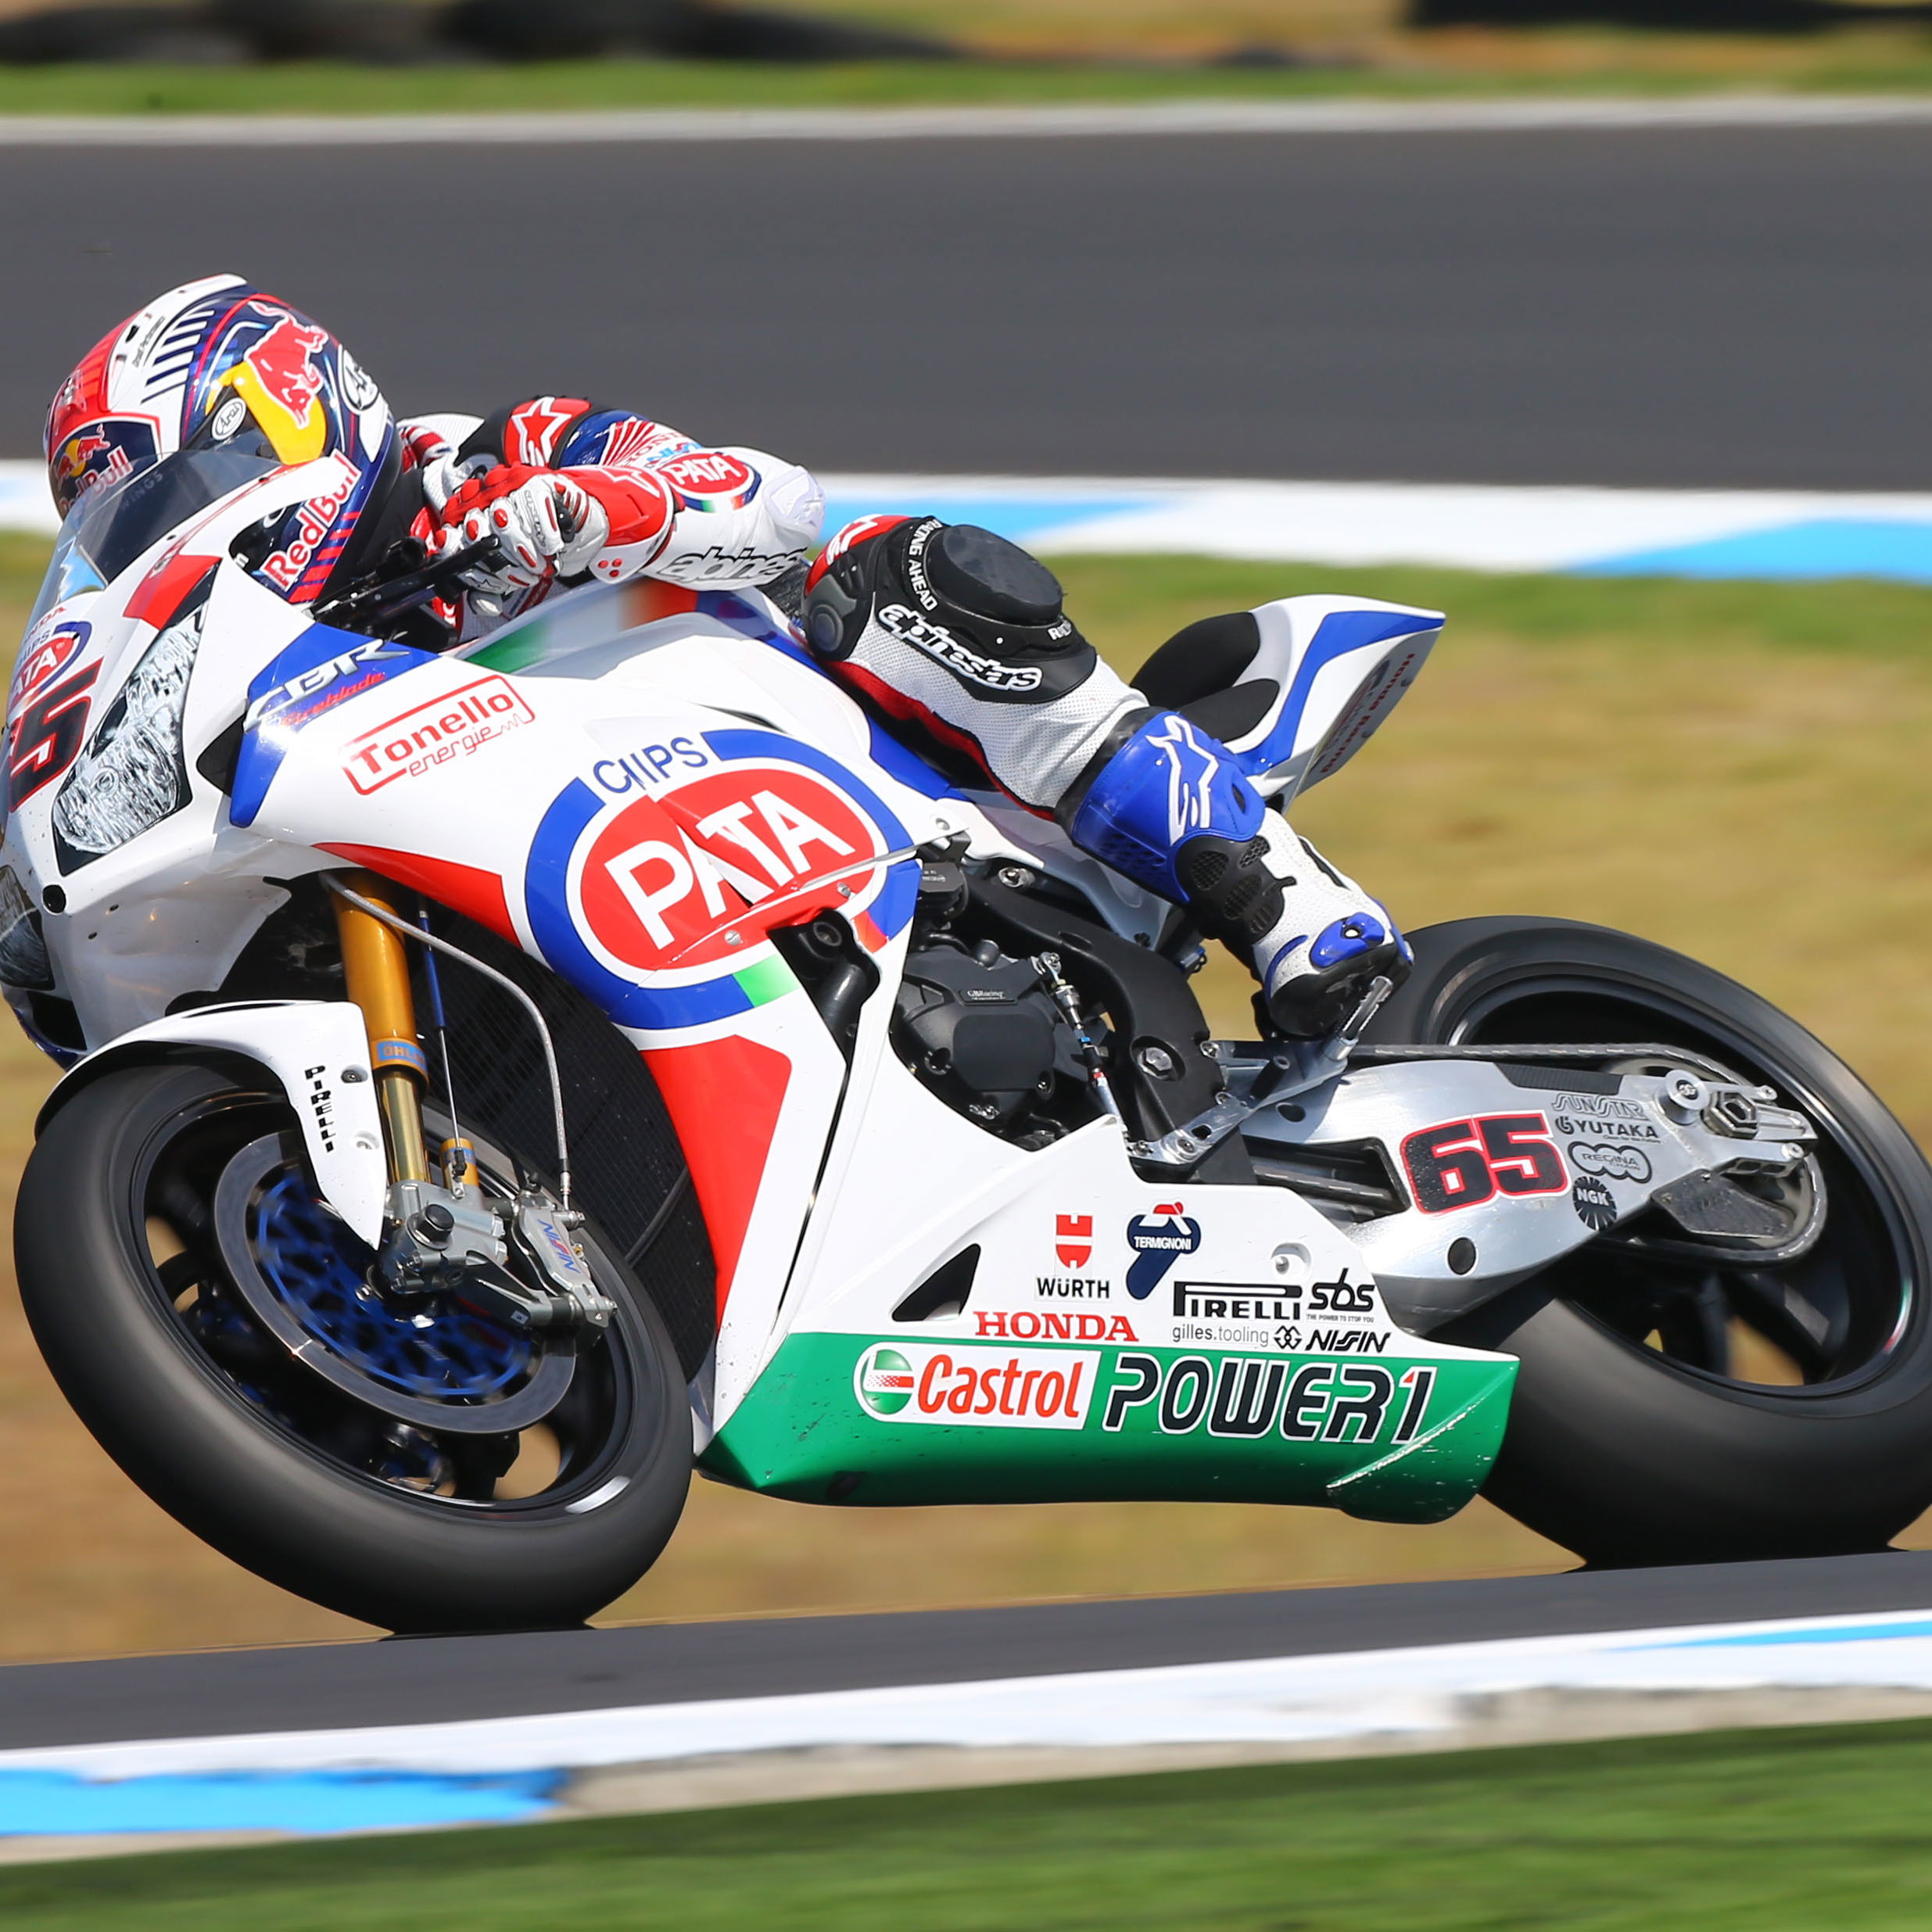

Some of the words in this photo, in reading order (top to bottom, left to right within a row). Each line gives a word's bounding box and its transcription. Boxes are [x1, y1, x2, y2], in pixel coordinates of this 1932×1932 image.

[665, 456, 742, 486] PATA
[261, 508, 328, 592] Red
[306, 449, 362, 529] Bul
[909, 518, 943, 556] RACING
[908, 558, 938, 611] AHEAD
[879, 604, 1043, 691] alpinestars
[11, 648, 58, 697] ATA
[243, 638, 410, 734] CBR
[9, 655, 105, 813] 5
[349, 692, 515, 775] Tonello
[408, 726, 497, 777] energie
[604, 790, 856, 950] PATA
[305, 1065, 335, 1152] PIRELLI
[1552, 1093, 1651, 1122] SUNSTAR
[1574, 1120, 1660, 1139] YUTAKA
[1400, 1109, 1572, 1216] 65
[1583, 1153, 1639, 1167] REGINA
[1576, 1188, 1610, 1206] NGK
[537, 1218, 582, 1274] NISSIN
[1134, 1235, 1192, 1250] TERMIGNONI
[1037, 1278, 1110, 1299] WÜRTH
[1173, 1281, 1303, 1321] PIRELLI
[1308, 1267, 1376, 1312] sbs
[973, 1310, 1140, 1342] HONDA
[1172, 1324, 1269, 1347] gilles.tooling
[1305, 1330, 1392, 1353] NISSIN
[918, 1353, 1084, 1418] Castrol
[1102, 1353, 1439, 1445] POWER1
